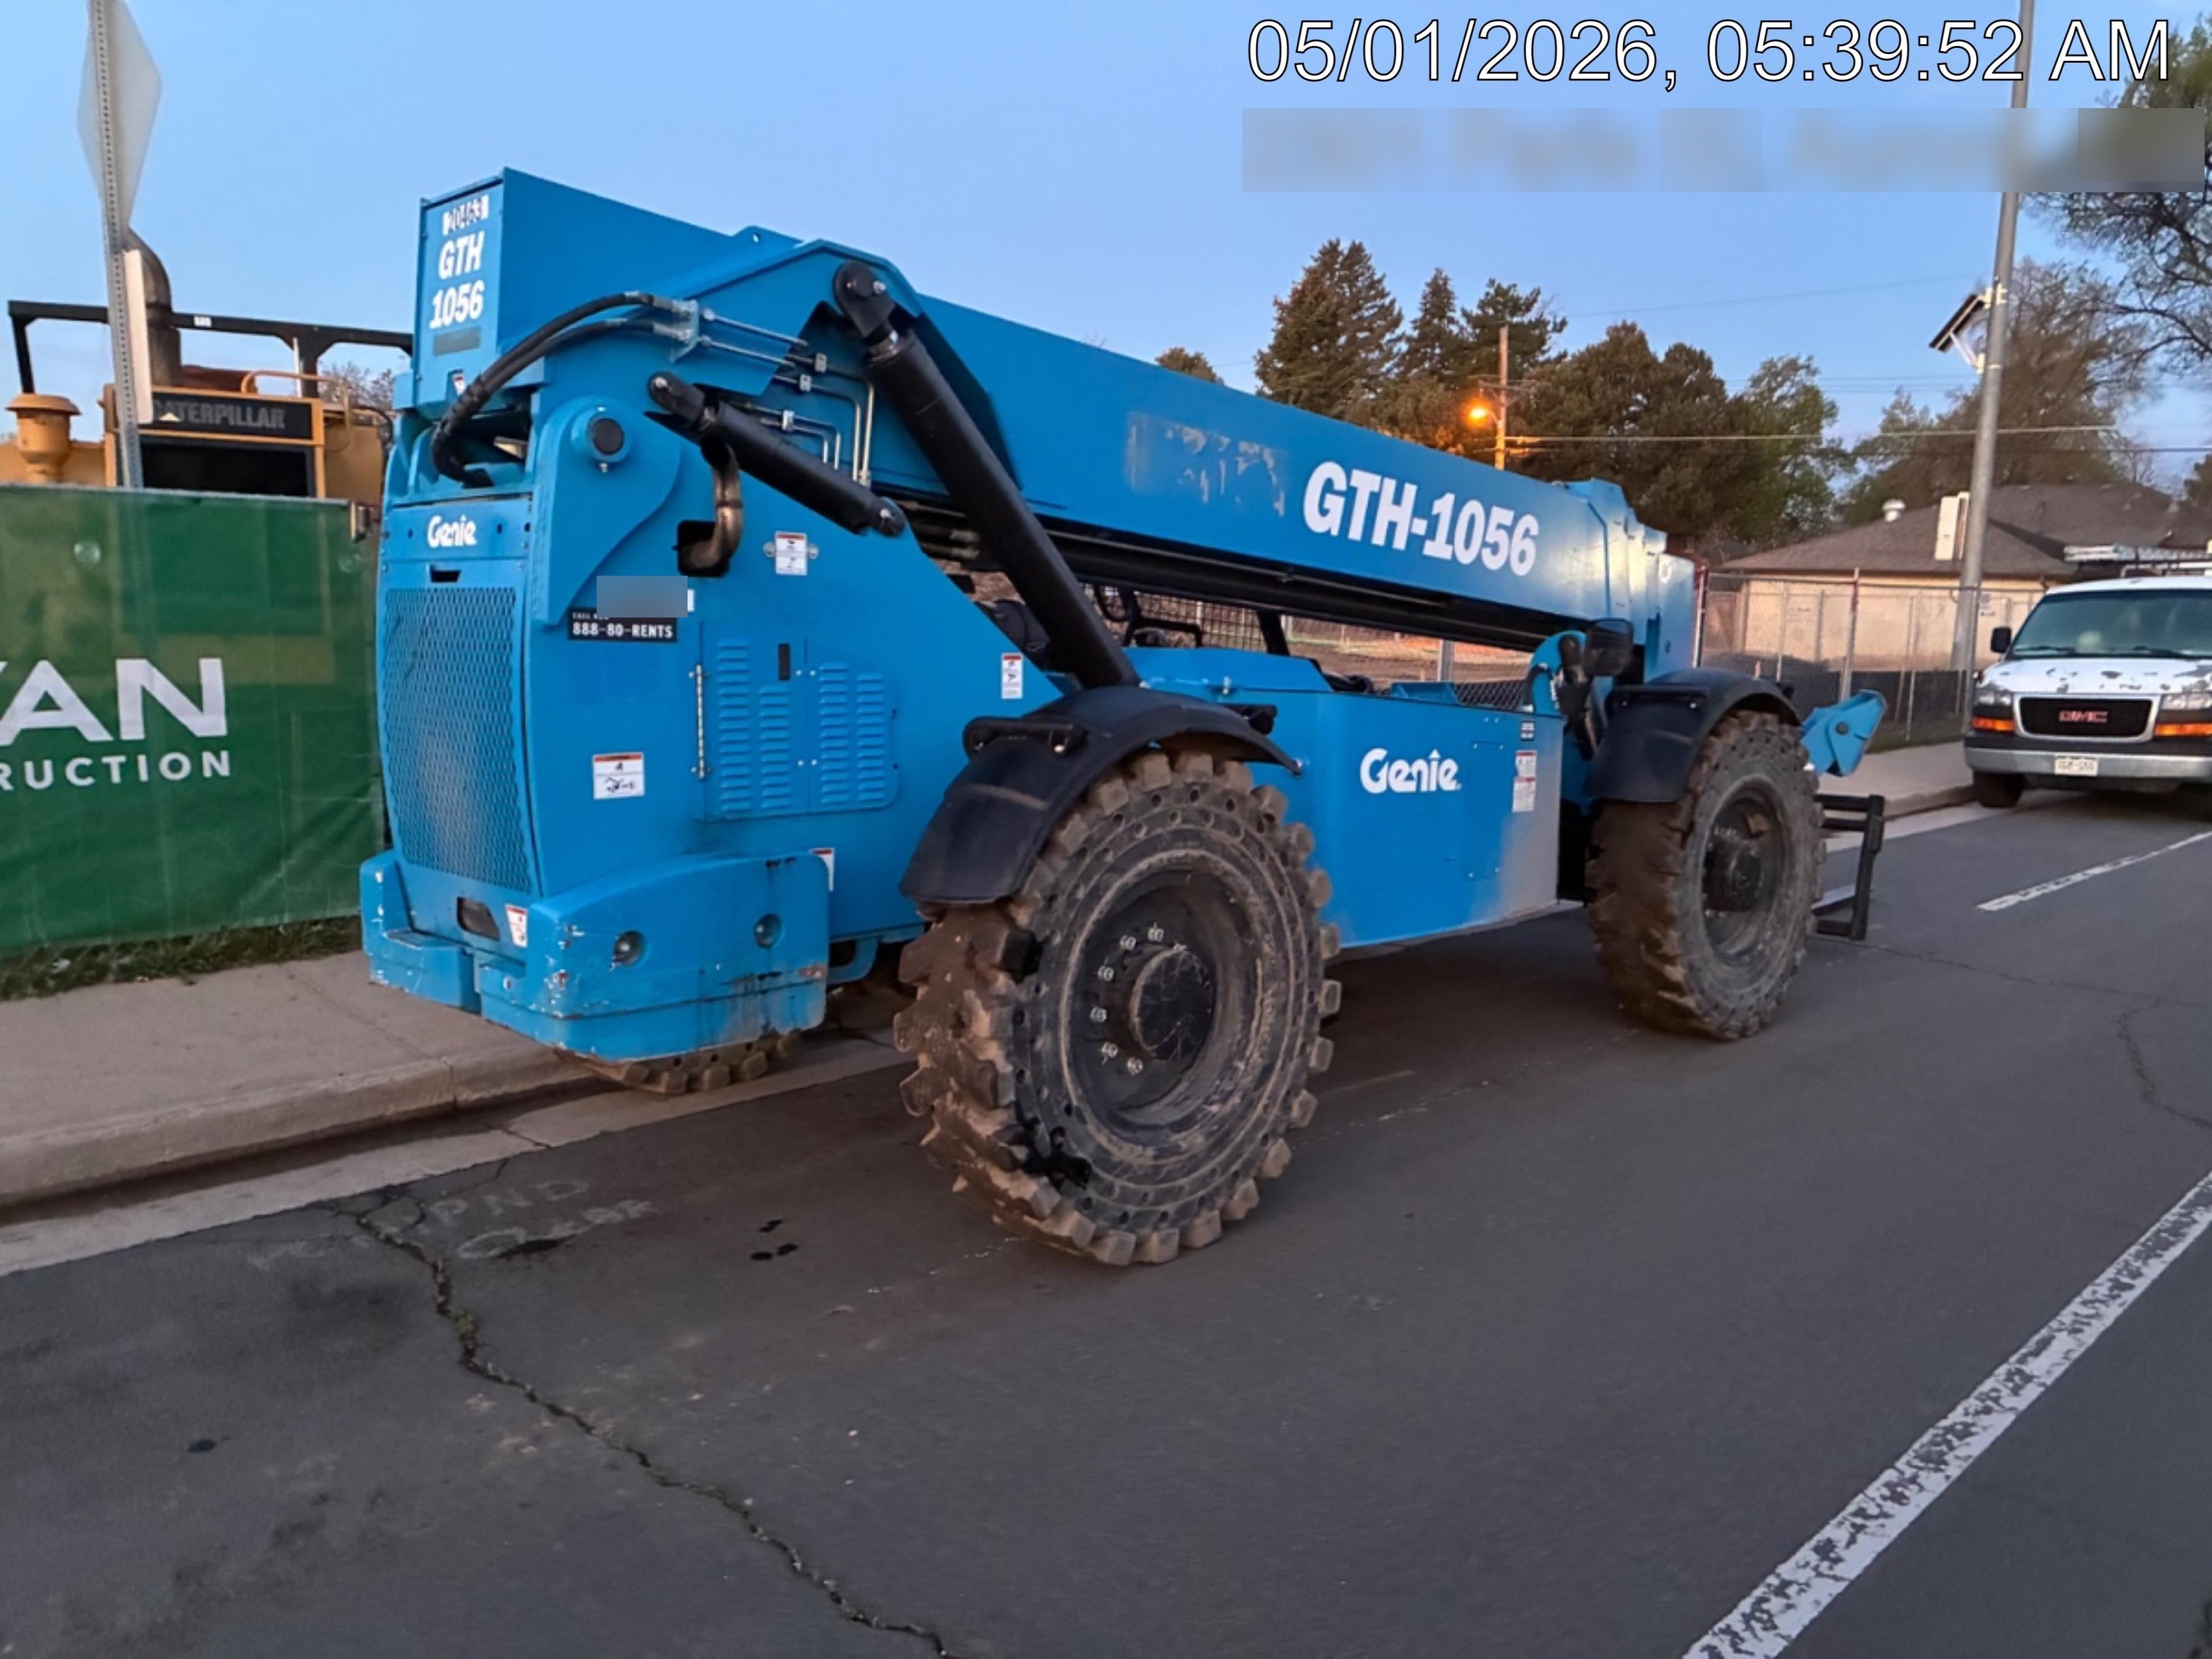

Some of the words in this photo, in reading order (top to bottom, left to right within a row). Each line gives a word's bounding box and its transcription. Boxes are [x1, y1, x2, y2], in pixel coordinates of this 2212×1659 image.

[438, 230, 485, 280] GTH
[429, 279, 485, 329] 1056
[427, 514, 478, 549] Genie
[1303, 461, 1539, 576] GTH-1056
[572, 621, 673, 639] 888-80-RENTS
[0, 657, 228, 746] AN
[2058, 710, 2108, 723] GMC
[1360, 747, 1462, 794] Genie
